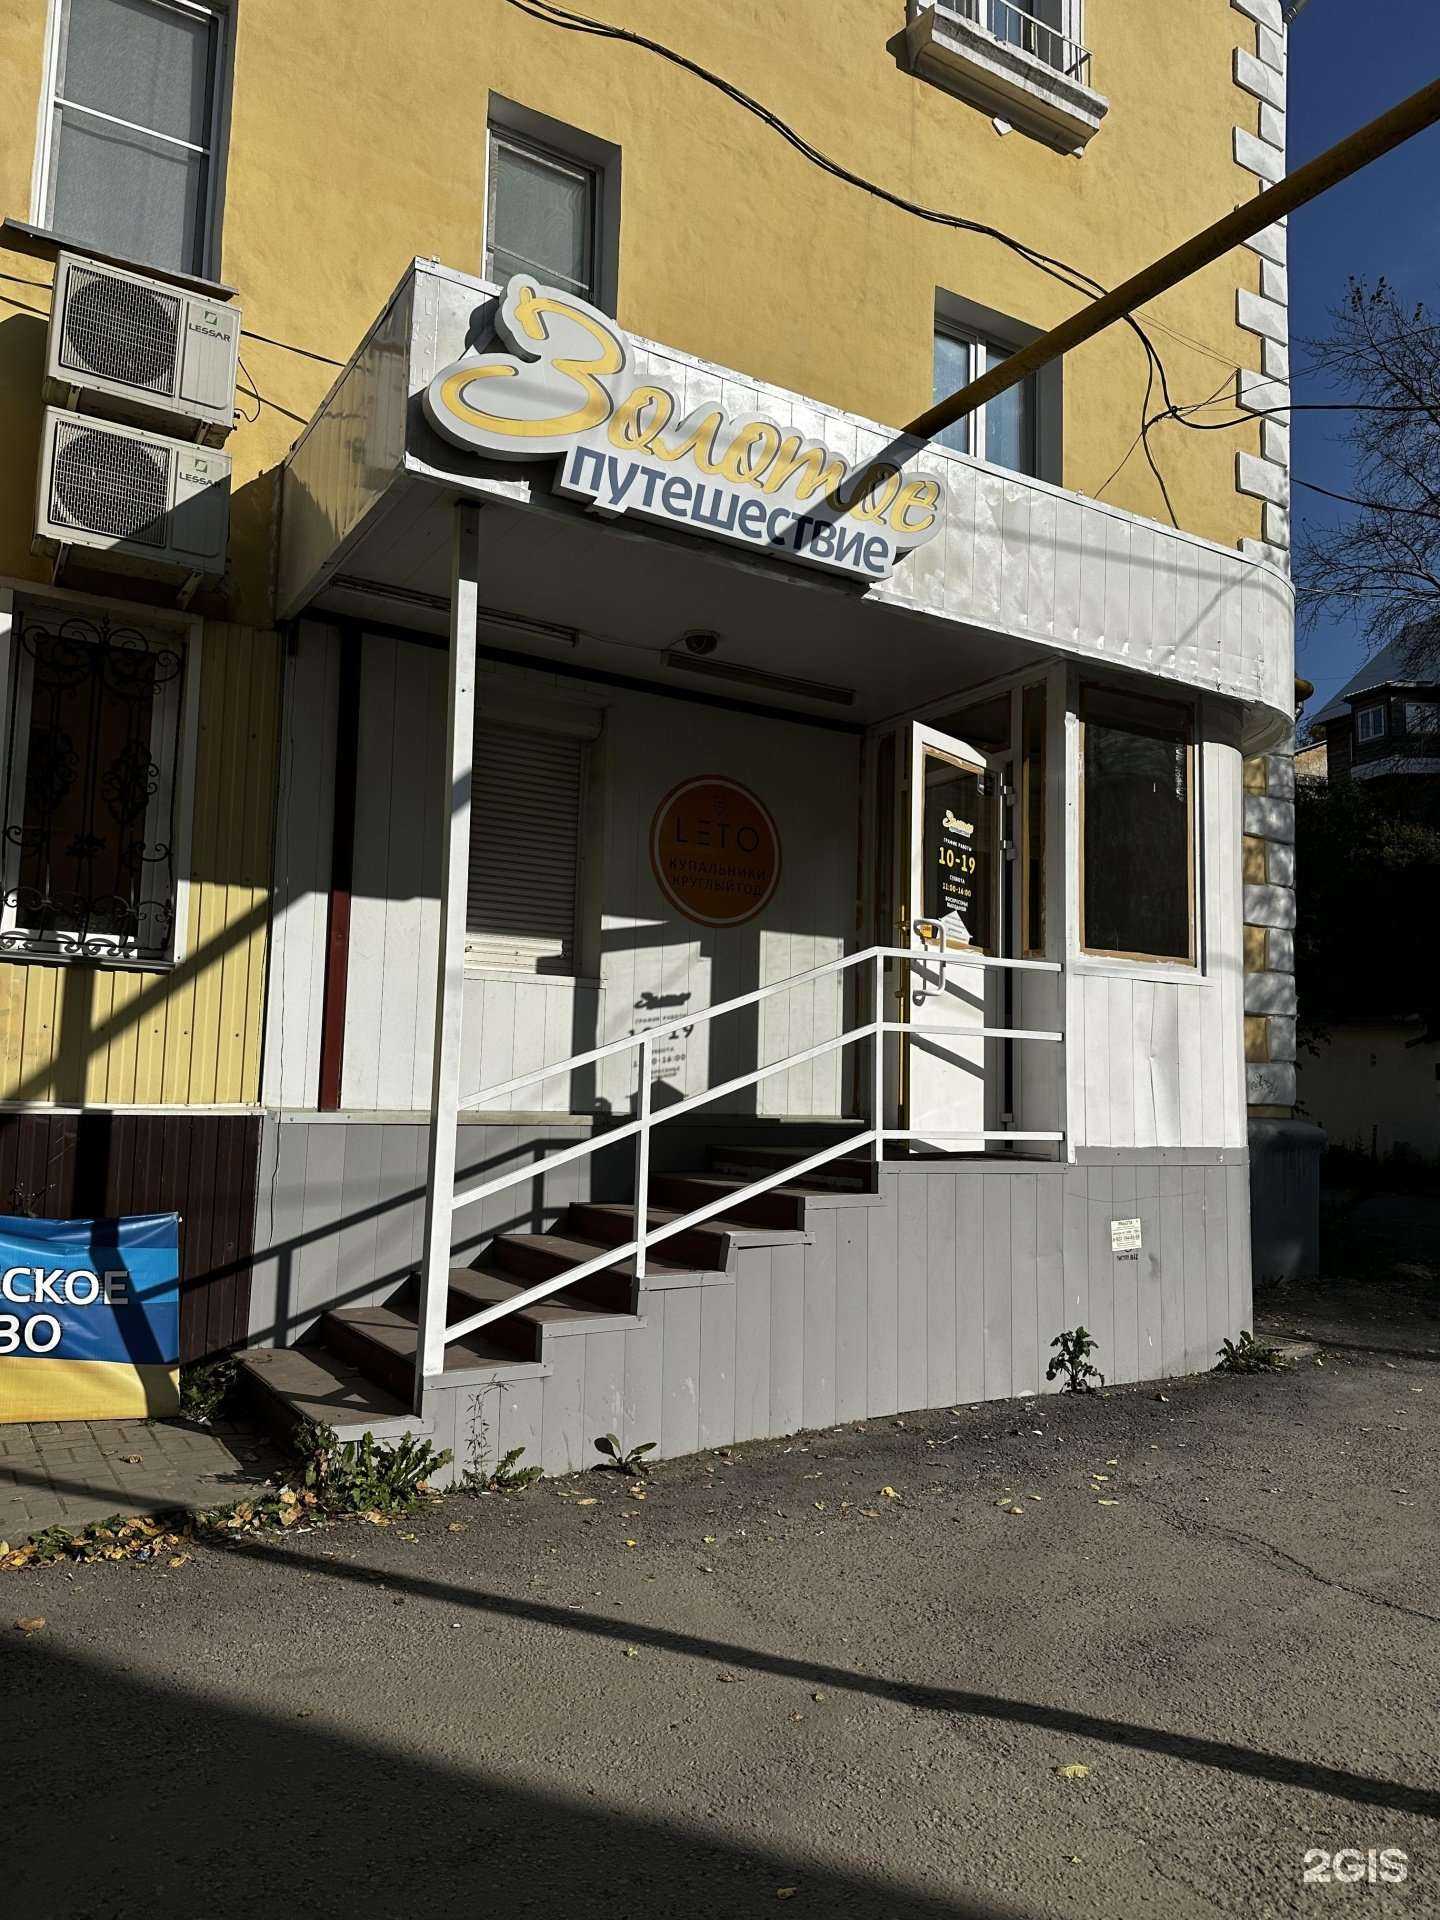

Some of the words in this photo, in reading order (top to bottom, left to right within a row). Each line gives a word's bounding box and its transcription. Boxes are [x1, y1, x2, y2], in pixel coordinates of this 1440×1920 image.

[188, 322, 231, 343] LESSAR
[179, 471, 221, 489] LESSAR
[669, 857, 768, 881] КУПАЛЬНИКИ
[938, 846, 976, 875] 10-19
